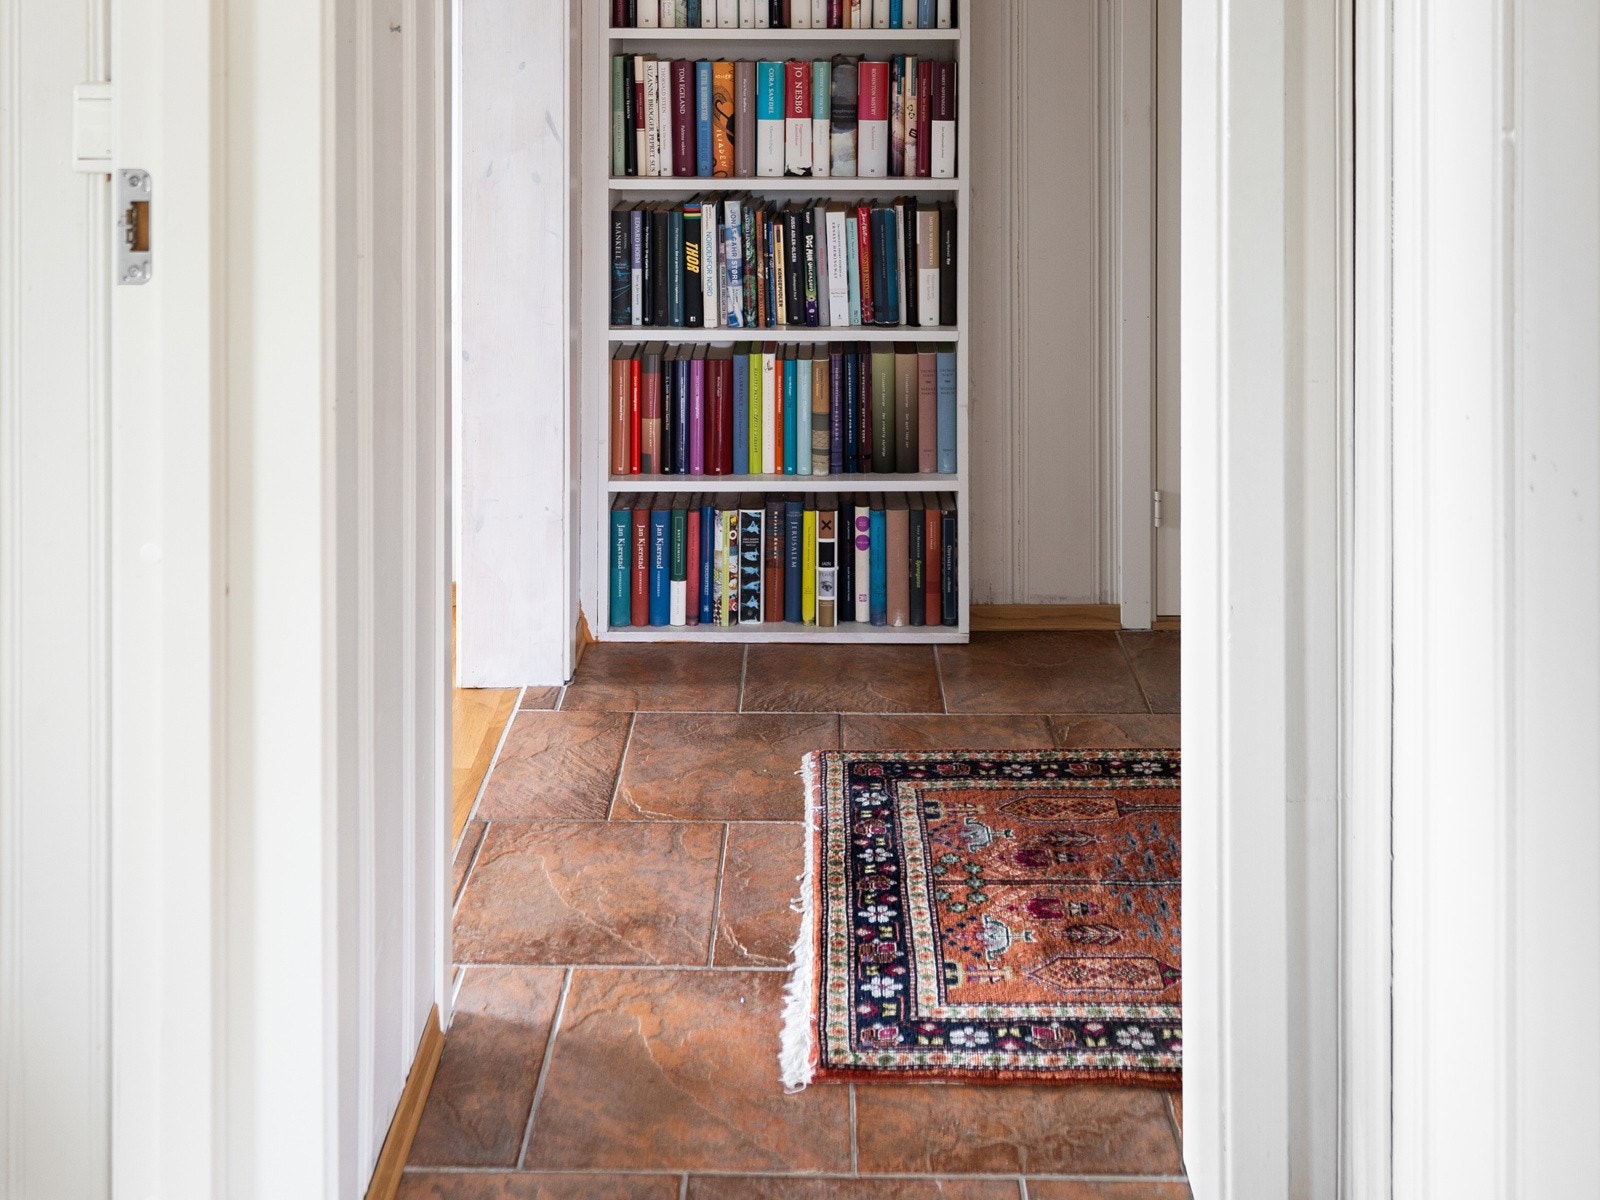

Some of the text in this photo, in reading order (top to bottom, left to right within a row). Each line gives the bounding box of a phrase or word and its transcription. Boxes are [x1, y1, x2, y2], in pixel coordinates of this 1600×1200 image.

[794, 67, 803, 114] JO NESBØ
[716, 129, 727, 167] ILIADEN
[685, 241, 699, 273] THOR
[805, 235, 813, 248] DOG
[616, 524, 625, 569] Jan Kjærstad
[637, 524, 645, 569] Jan Kjærstad
[656, 524, 664, 569] Jan Kjærstad
